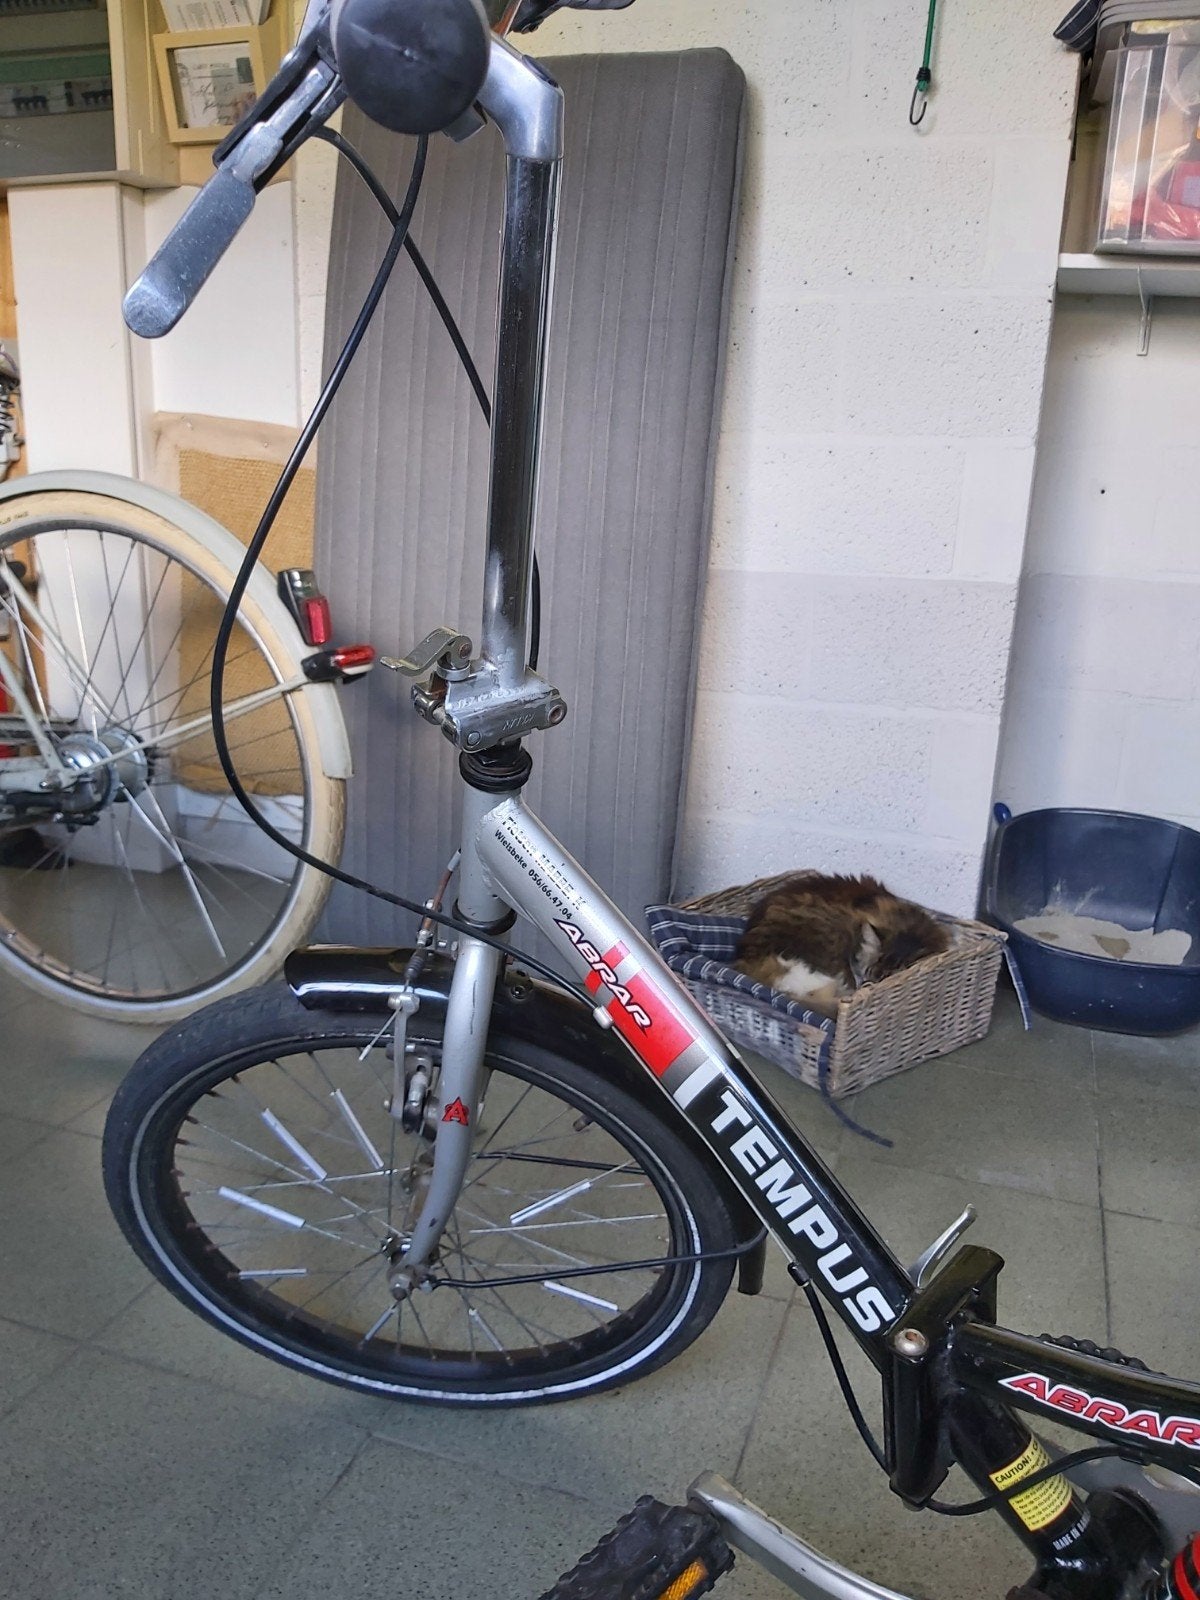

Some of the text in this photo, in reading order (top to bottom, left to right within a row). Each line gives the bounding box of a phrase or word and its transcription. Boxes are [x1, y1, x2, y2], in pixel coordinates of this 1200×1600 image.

[494, 829, 528, 869] Wielsbeke
[528, 869, 573, 920] 056/66.47.04
[553, 918, 653, 1036] ABRAR
[711, 1089, 896, 1333] TEMPUS
[999, 1374, 1200, 1449] ABRAR
[994, 1454, 1032, 1484] CAUTION!
